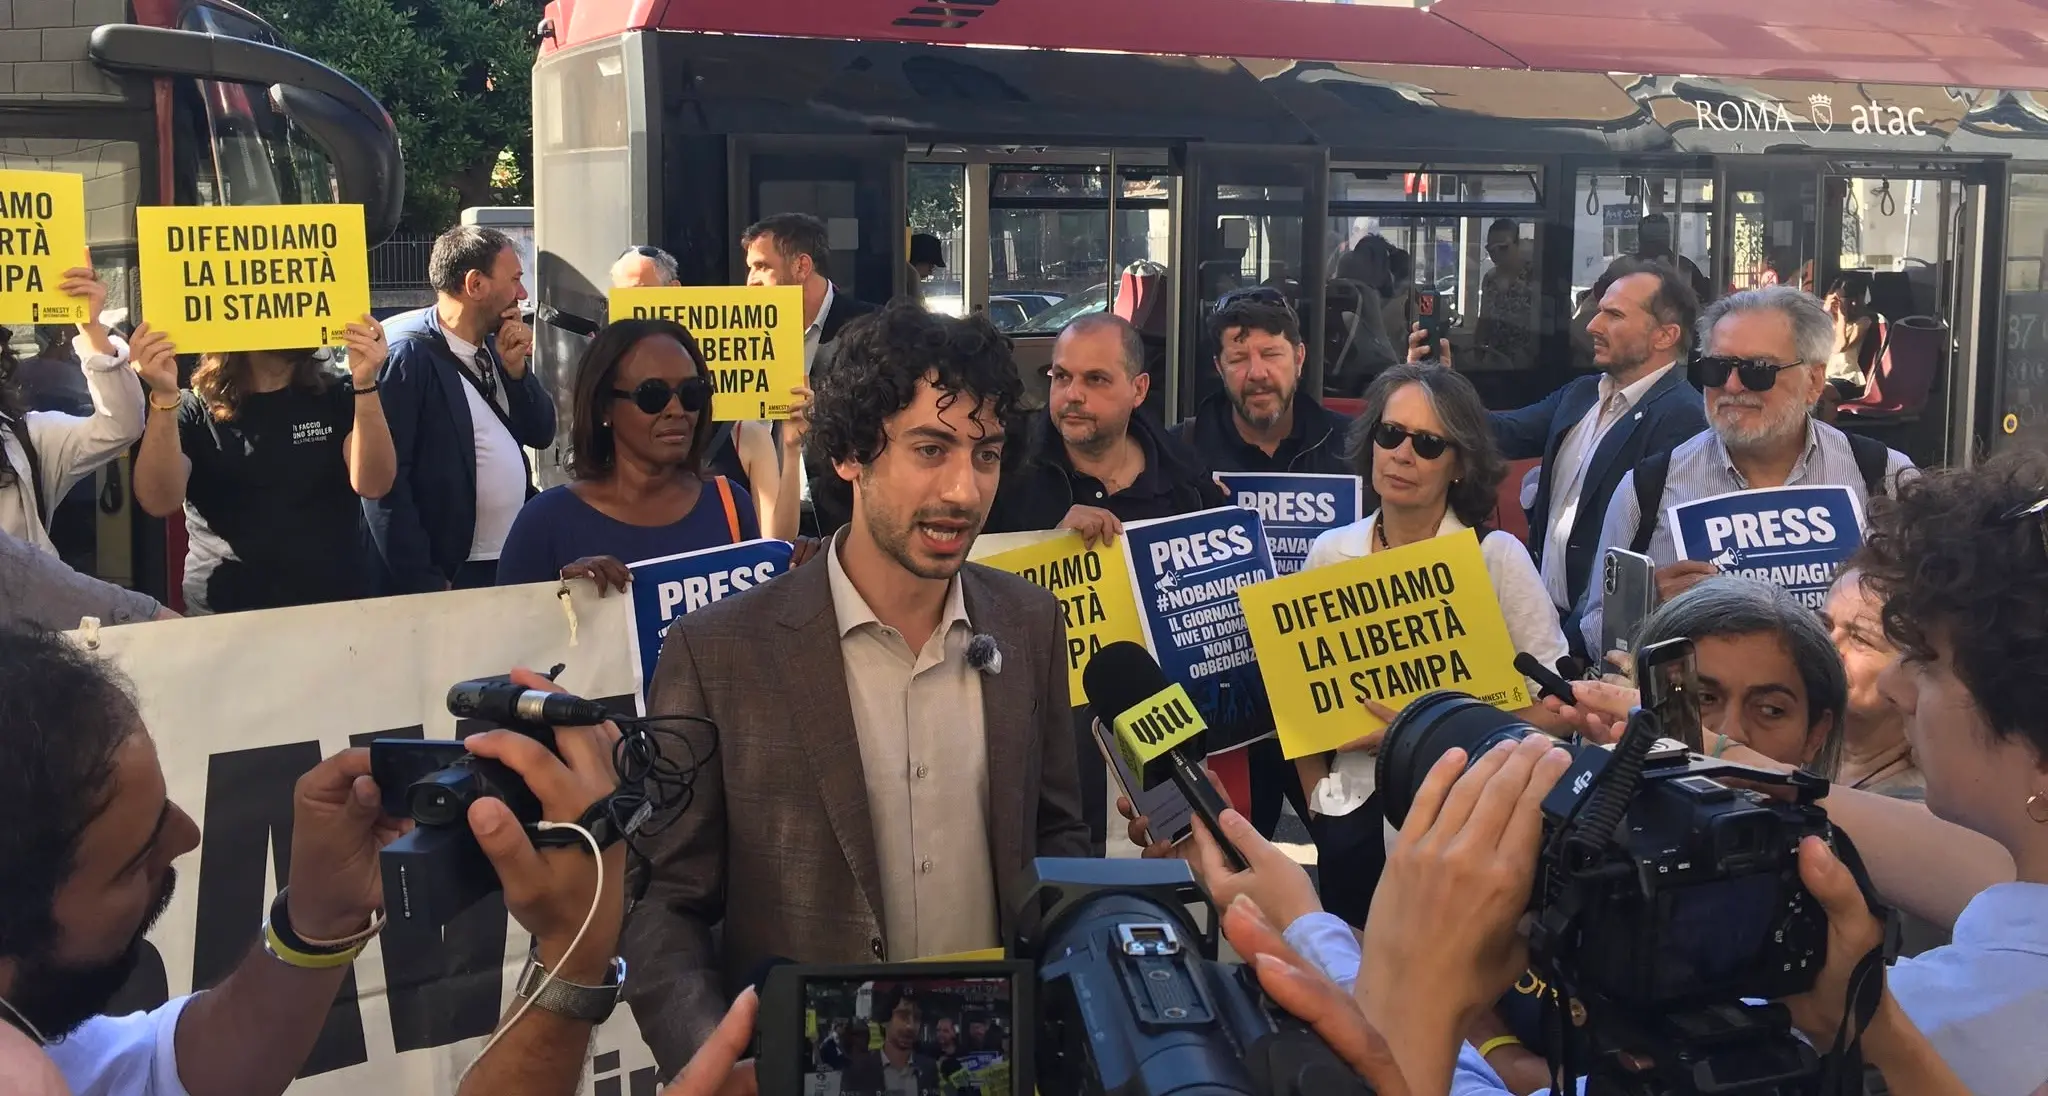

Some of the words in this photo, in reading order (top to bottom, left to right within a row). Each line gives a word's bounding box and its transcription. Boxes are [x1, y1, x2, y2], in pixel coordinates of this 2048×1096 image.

[1695, 100, 1796, 132] ROMA
[1850, 100, 1927, 136] atac
[167, 223, 338, 253] DIFENDIAMO
[184, 260, 215, 287] LA
[225, 252, 336, 286] LIBERTÀ
[185, 295, 212, 322] DI
[223, 291, 331, 321] STAMPA
[699, 331, 775, 361] BERTÀ
[711, 368, 770, 394] AMPA
[1238, 491, 1336, 523] PRESS
[1704, 506, 1836, 552] PRESS
[1149, 525, 1254, 575] PRESS
[1272, 562, 1456, 635] DIFENDIAMO
[1168, 617, 1182, 632] IL
[1182, 602, 1244, 629] GIORNALIS
[1172, 629, 1201, 648] VIVE
[1201, 625, 1215, 641] DI
[1215, 616, 1248, 637] DOMA
[1202, 639, 1232, 660] NON
[1234, 634, 1248, 650] DI
[1298, 636, 1337, 672] LA
[1339, 599, 1467, 663] LIBERTÀ
[1188, 648, 1257, 680] OBBEDIENZ
[1309, 678, 1344, 714] DI
[1350, 650, 1472, 705] STAMPA
